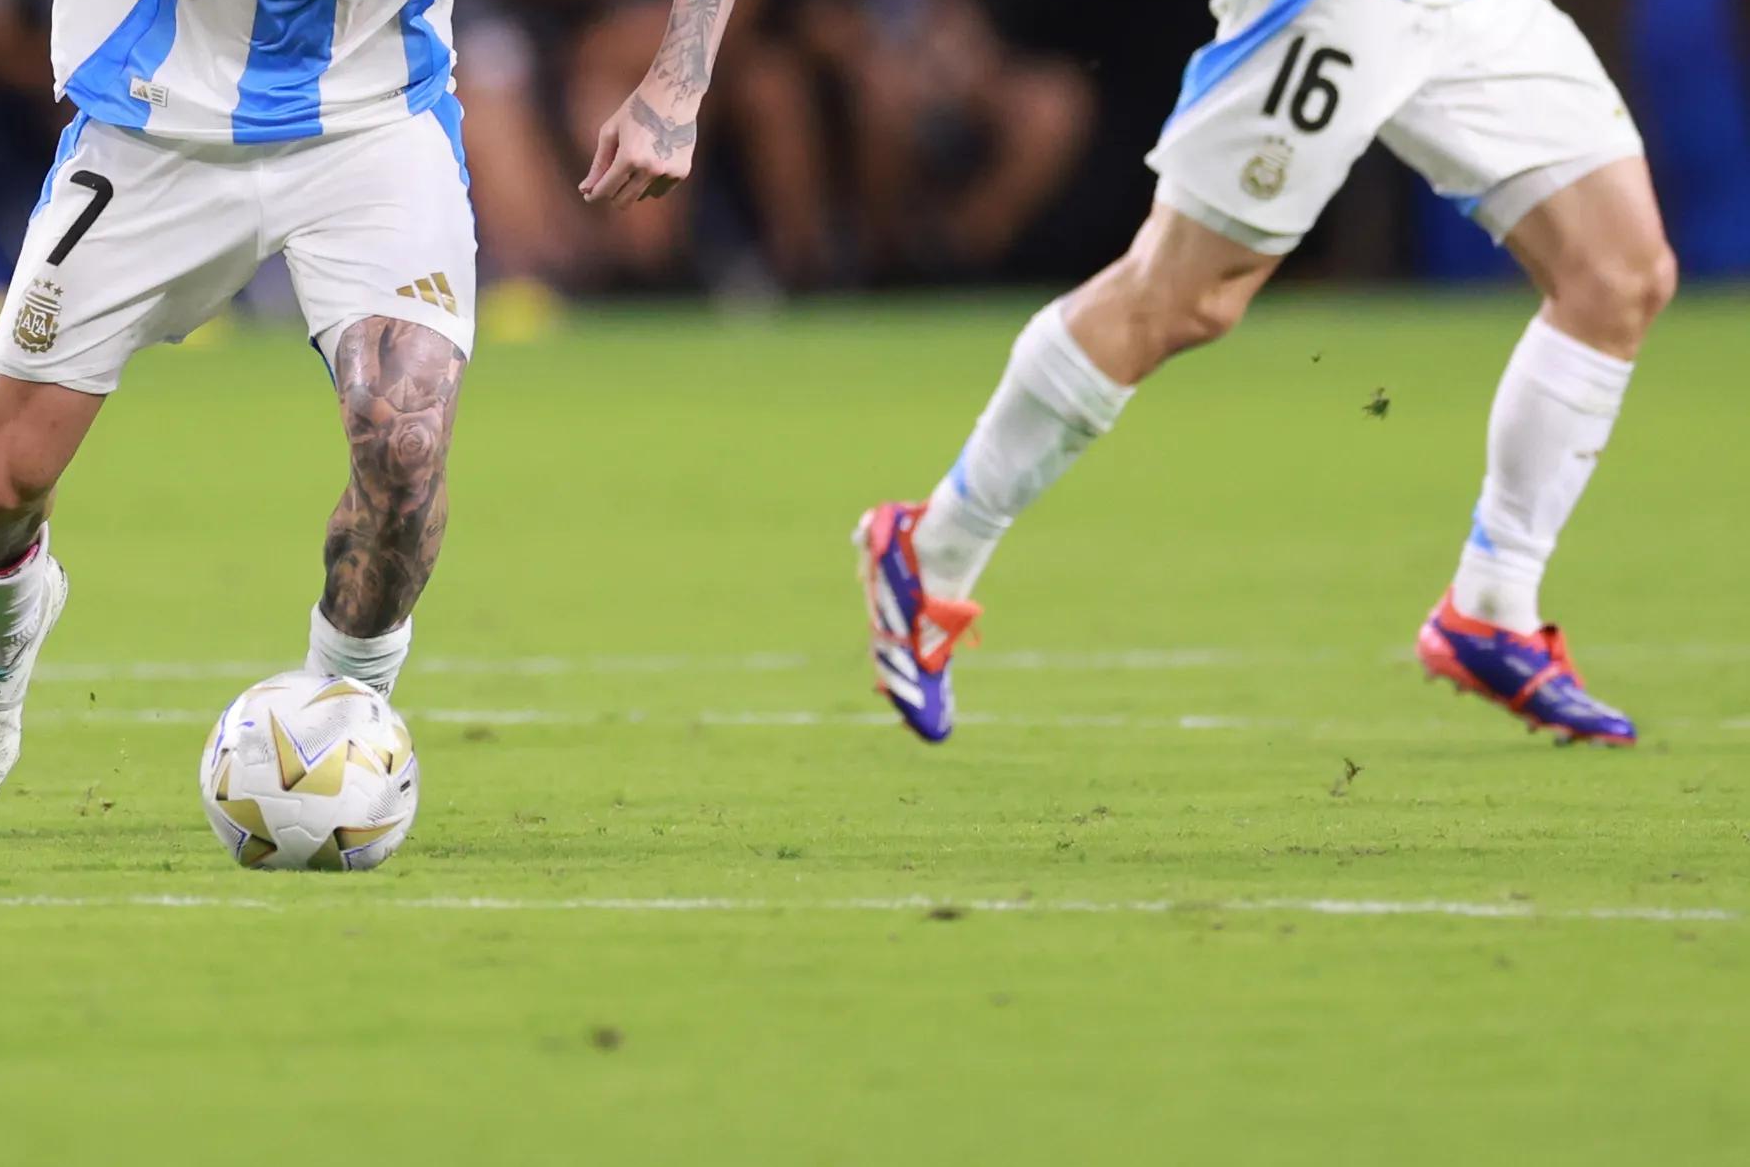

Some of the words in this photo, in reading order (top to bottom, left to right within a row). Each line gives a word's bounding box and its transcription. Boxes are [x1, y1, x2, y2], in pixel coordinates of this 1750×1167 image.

[1262, 35, 1354, 133] 16
[46, 169, 114, 267] 7
[21, 307, 47, 338] AFA
